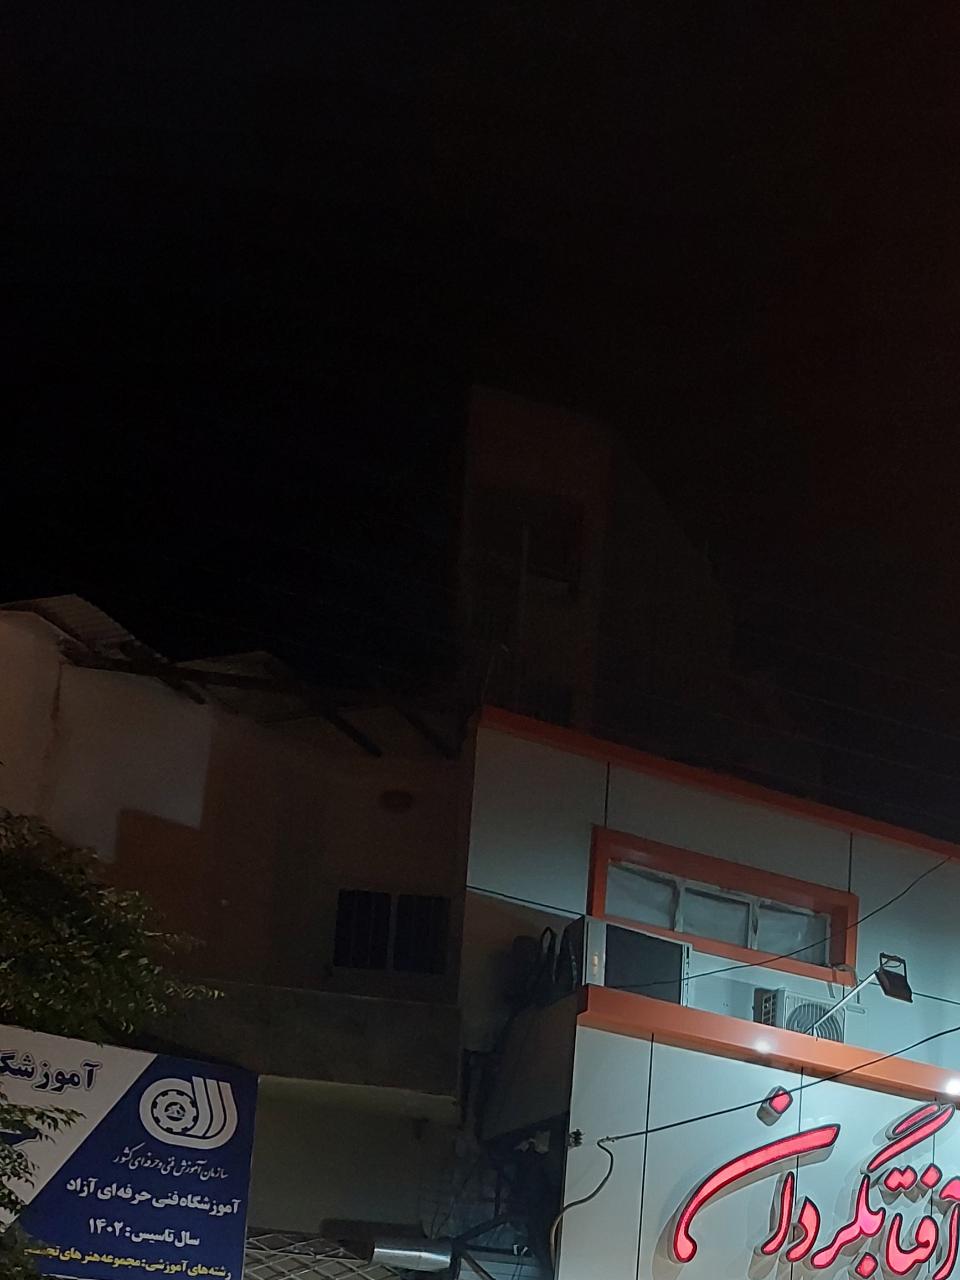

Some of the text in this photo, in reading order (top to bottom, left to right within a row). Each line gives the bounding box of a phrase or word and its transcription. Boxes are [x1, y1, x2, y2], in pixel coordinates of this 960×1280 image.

[113, 1142, 145, 1163] کشور
[160, 1156, 176, 1174] فنی
[173, 1158, 207, 1176] آموزش
[200, 1164, 228, 1180] سازمان
[66, 1177, 98, 1197] آزاد
[152, 1190, 179, 1208] فنی
[180, 1193, 242, 1215] آموزشگاه
[89, 1217, 123, 1236] ۱۴۰۲
[174, 1231, 200, 1247] سال
[100, 1254, 140, 1268] مجموعه
